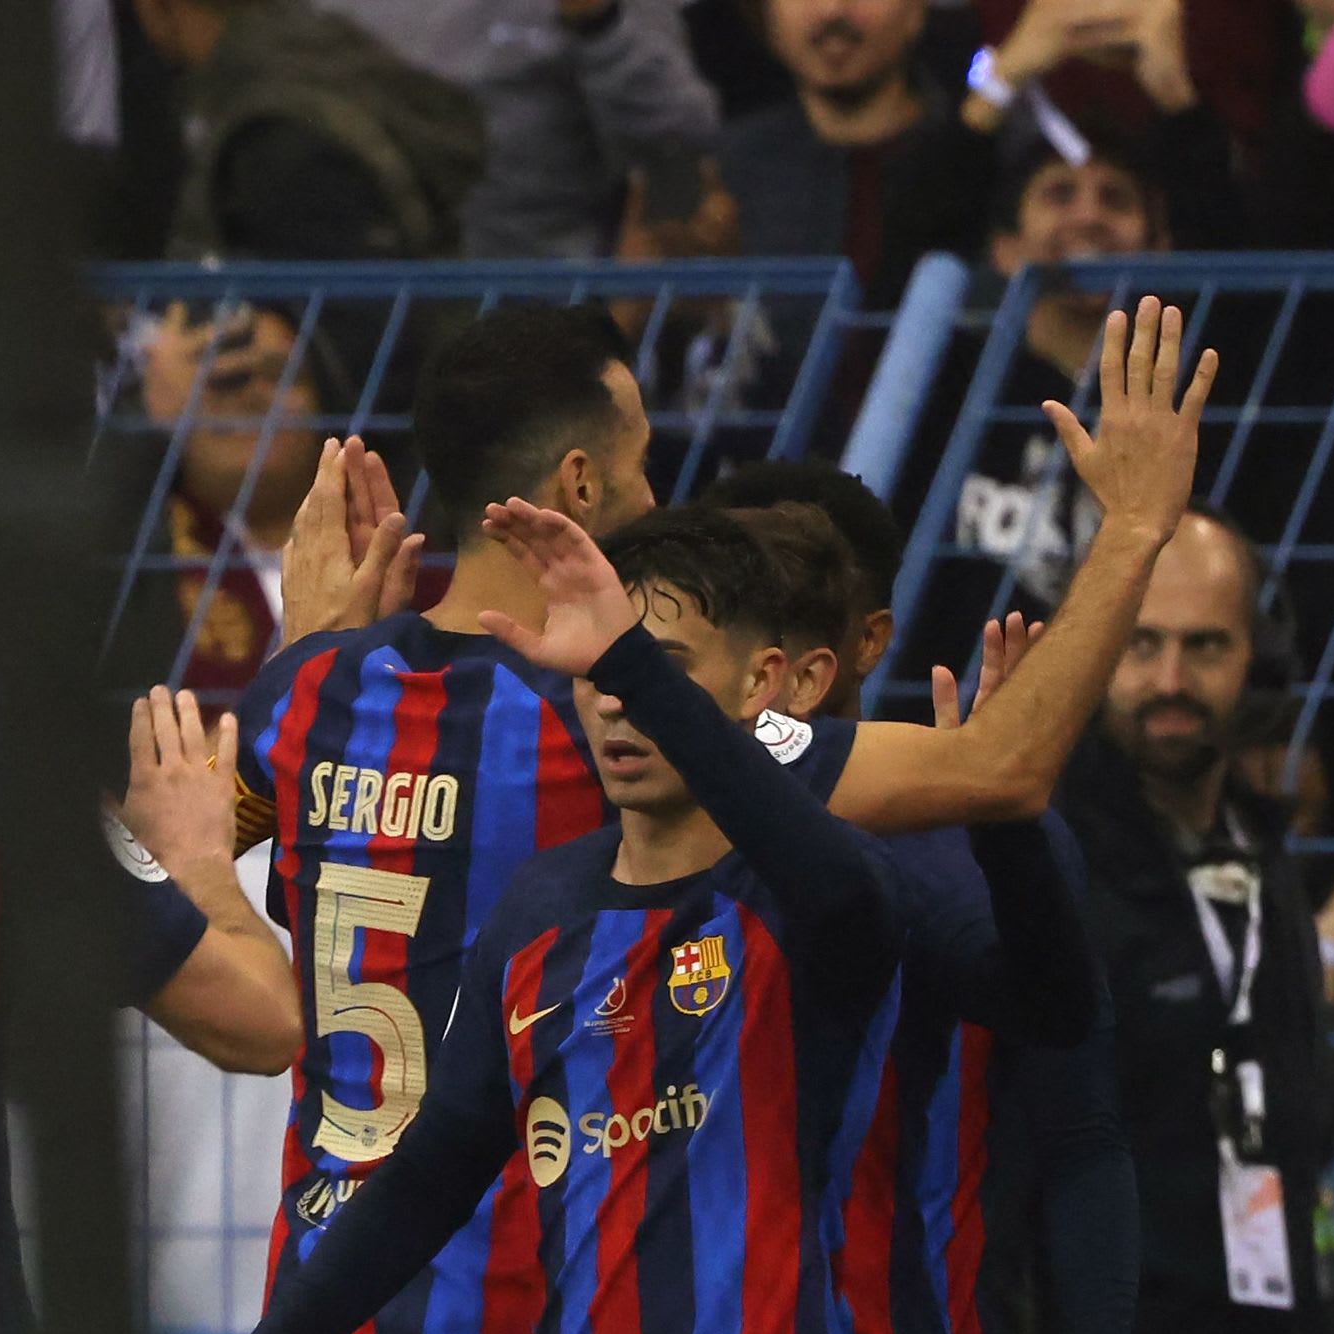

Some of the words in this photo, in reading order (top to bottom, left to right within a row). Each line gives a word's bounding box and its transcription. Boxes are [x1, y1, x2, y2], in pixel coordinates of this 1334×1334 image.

[308, 761, 459, 842] SERGIO
[311, 861, 431, 1162] 5
[688, 969, 712, 983] FCB
[578, 1082, 717, 1159] Spotify
